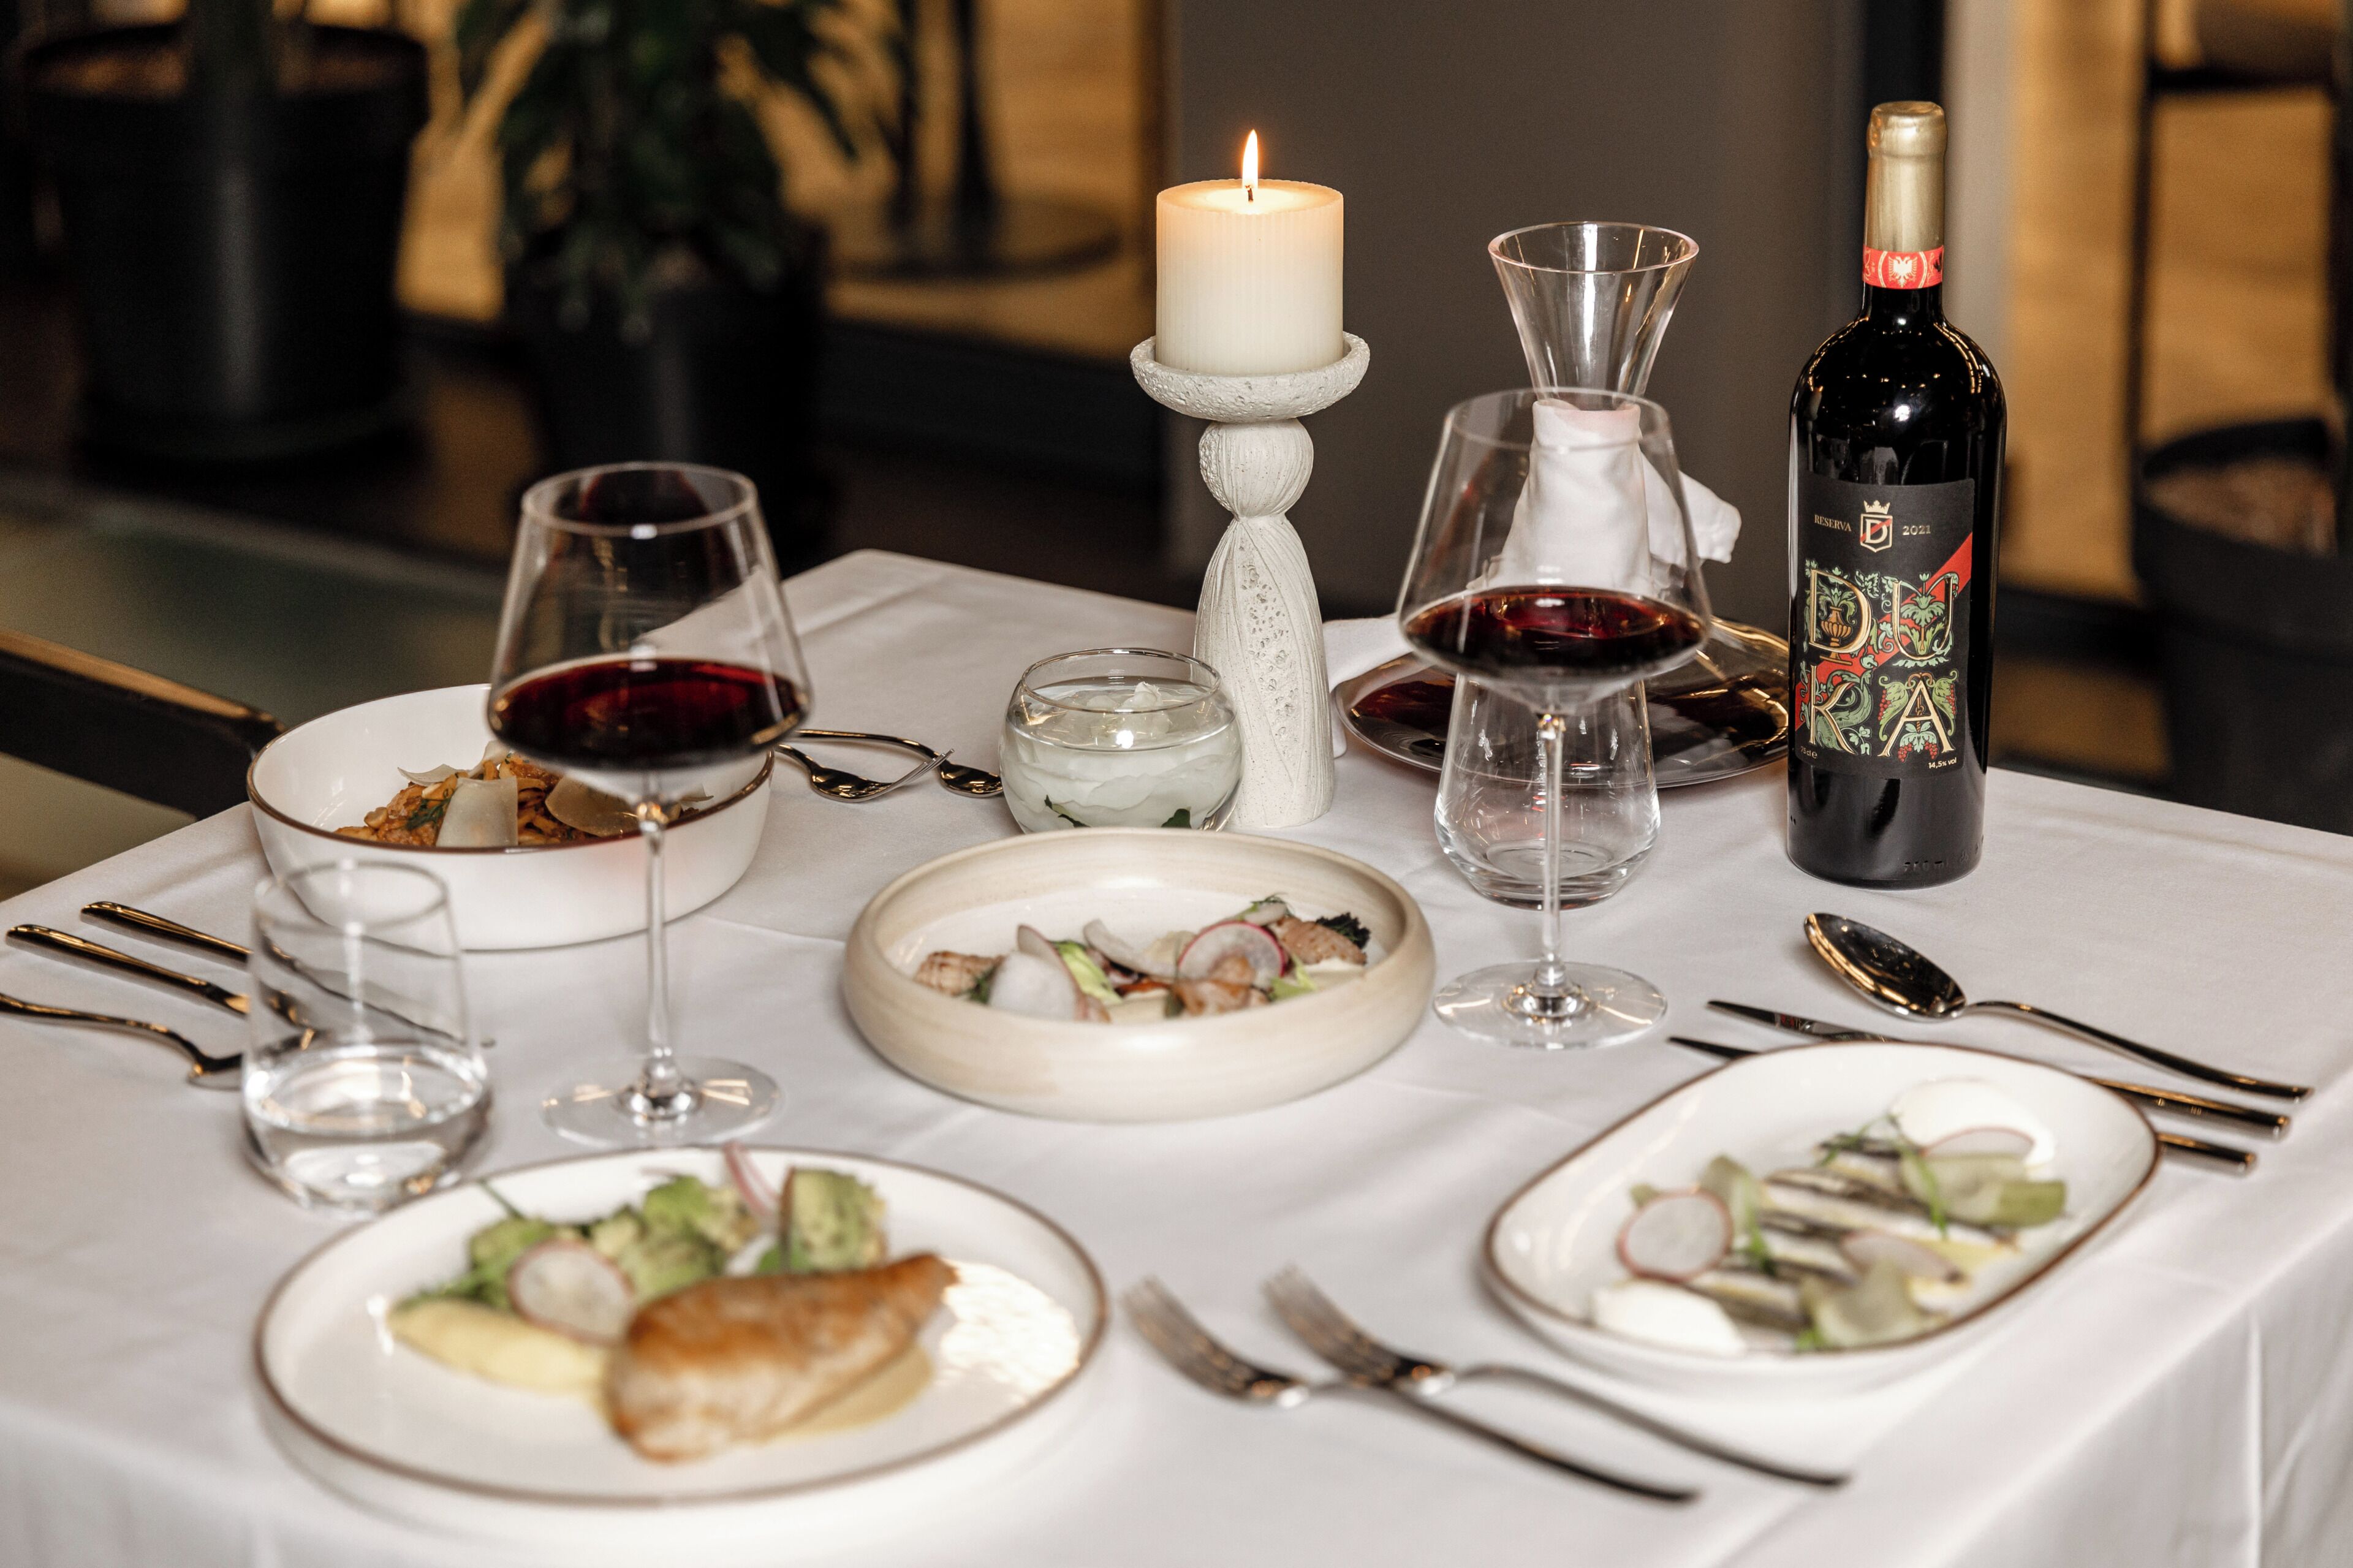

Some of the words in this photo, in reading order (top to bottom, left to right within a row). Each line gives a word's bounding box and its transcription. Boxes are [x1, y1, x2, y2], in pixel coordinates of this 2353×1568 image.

[1814, 514, 1852, 532] RESERVA
[1902, 525, 1931, 536] 2021
[1865, 518, 1888, 544] D
[1928, 760, 1947, 769] 14,5%
[1948, 757, 1957, 765] vol
